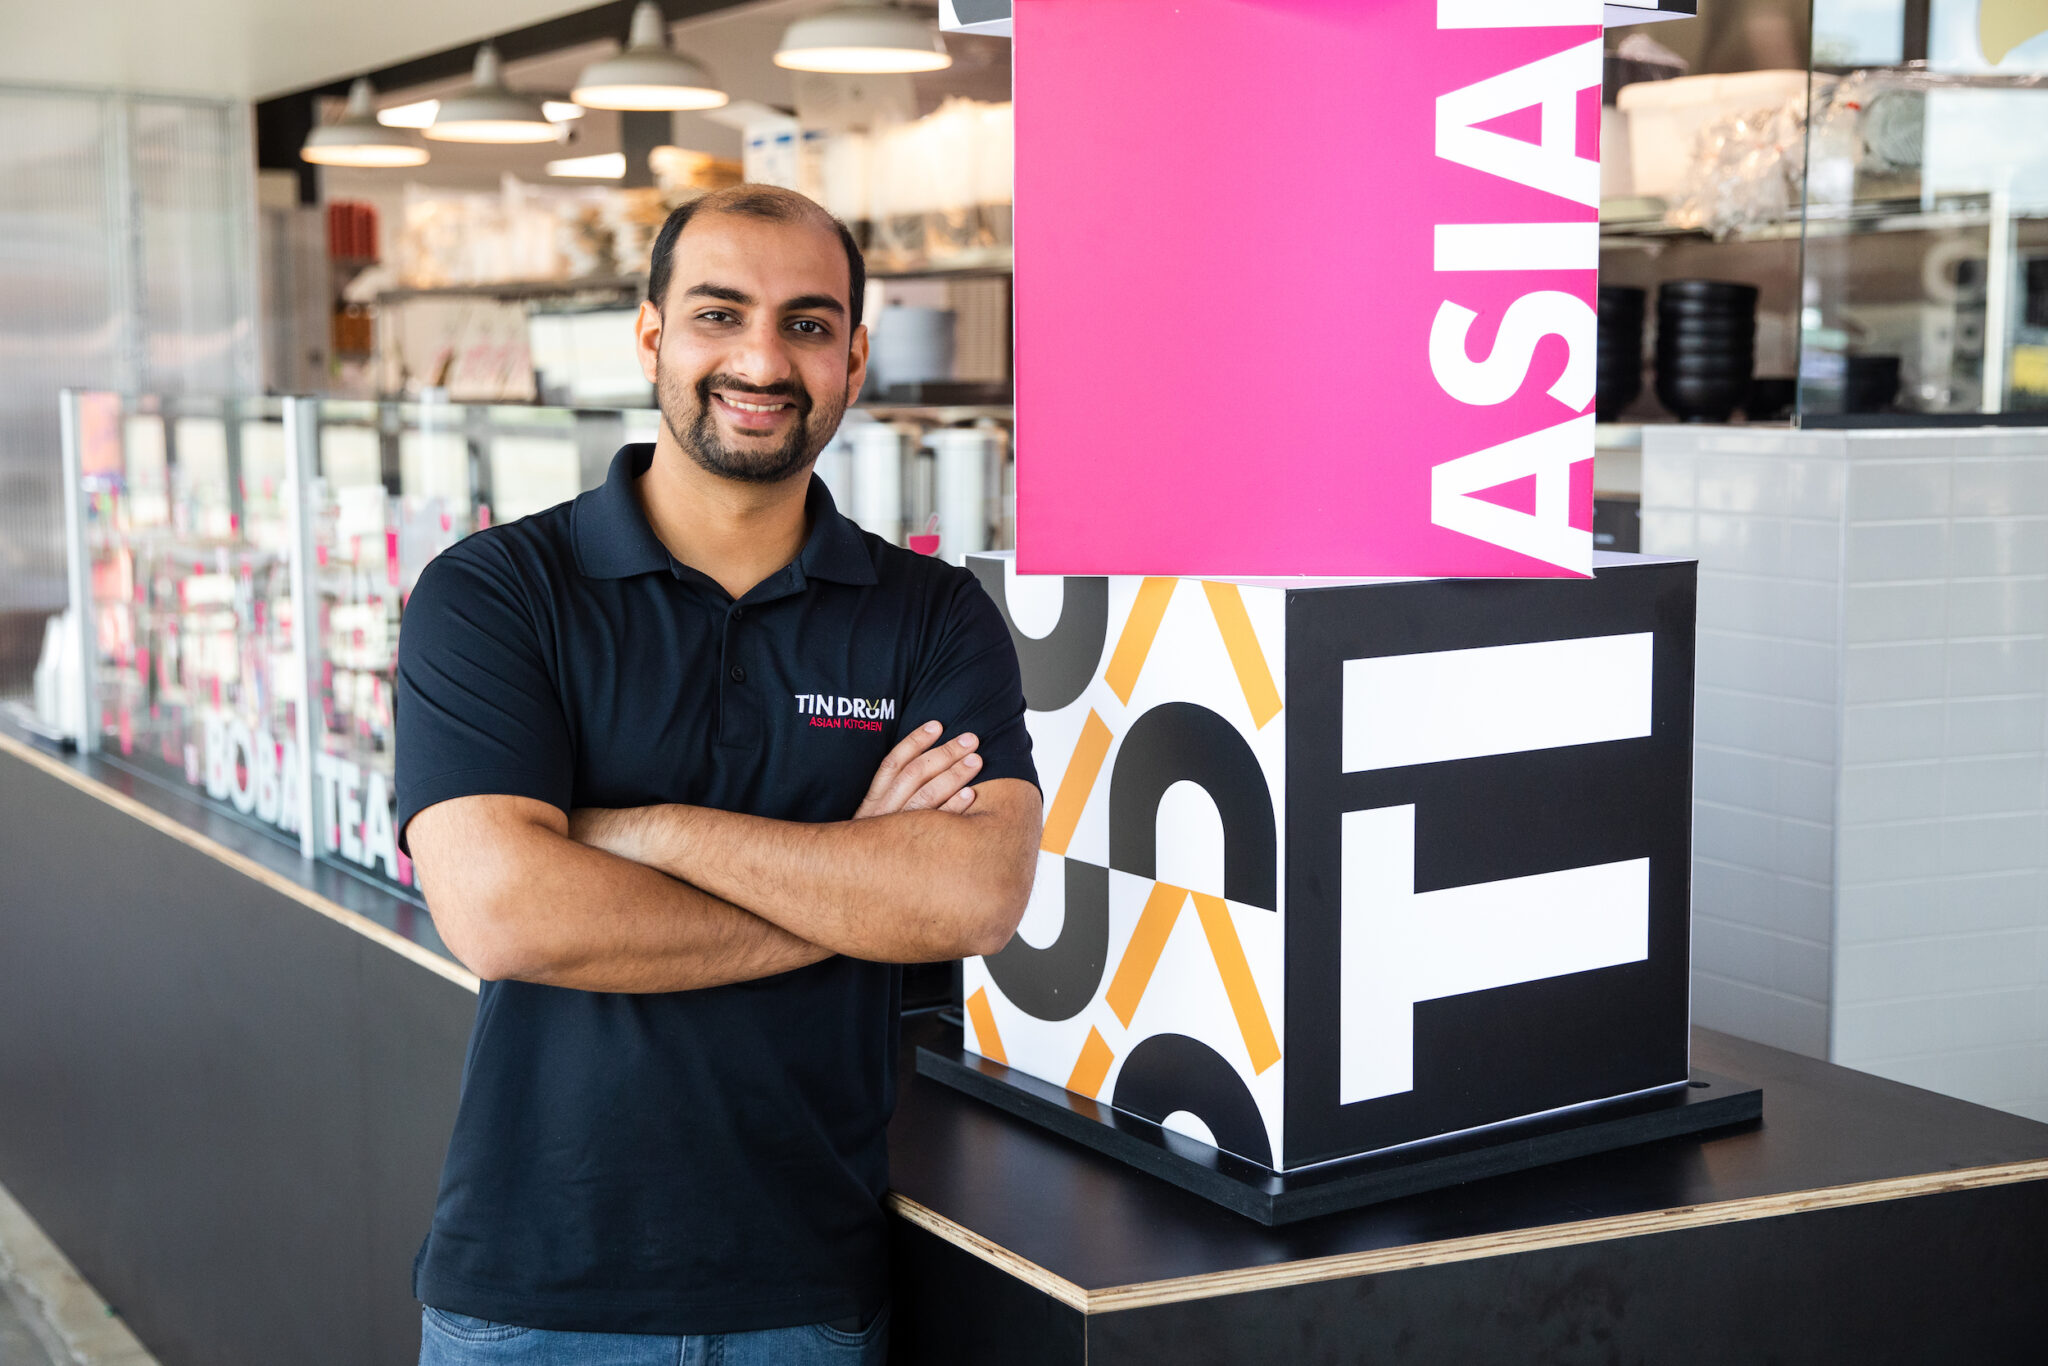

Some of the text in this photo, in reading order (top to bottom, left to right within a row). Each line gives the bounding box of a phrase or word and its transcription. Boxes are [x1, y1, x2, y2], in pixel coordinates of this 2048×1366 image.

[795, 694, 895, 720] TIN DRUM
[809, 716, 883, 732] ASIAN KITCHEN
[204, 708, 399, 882] BOBA TEA
